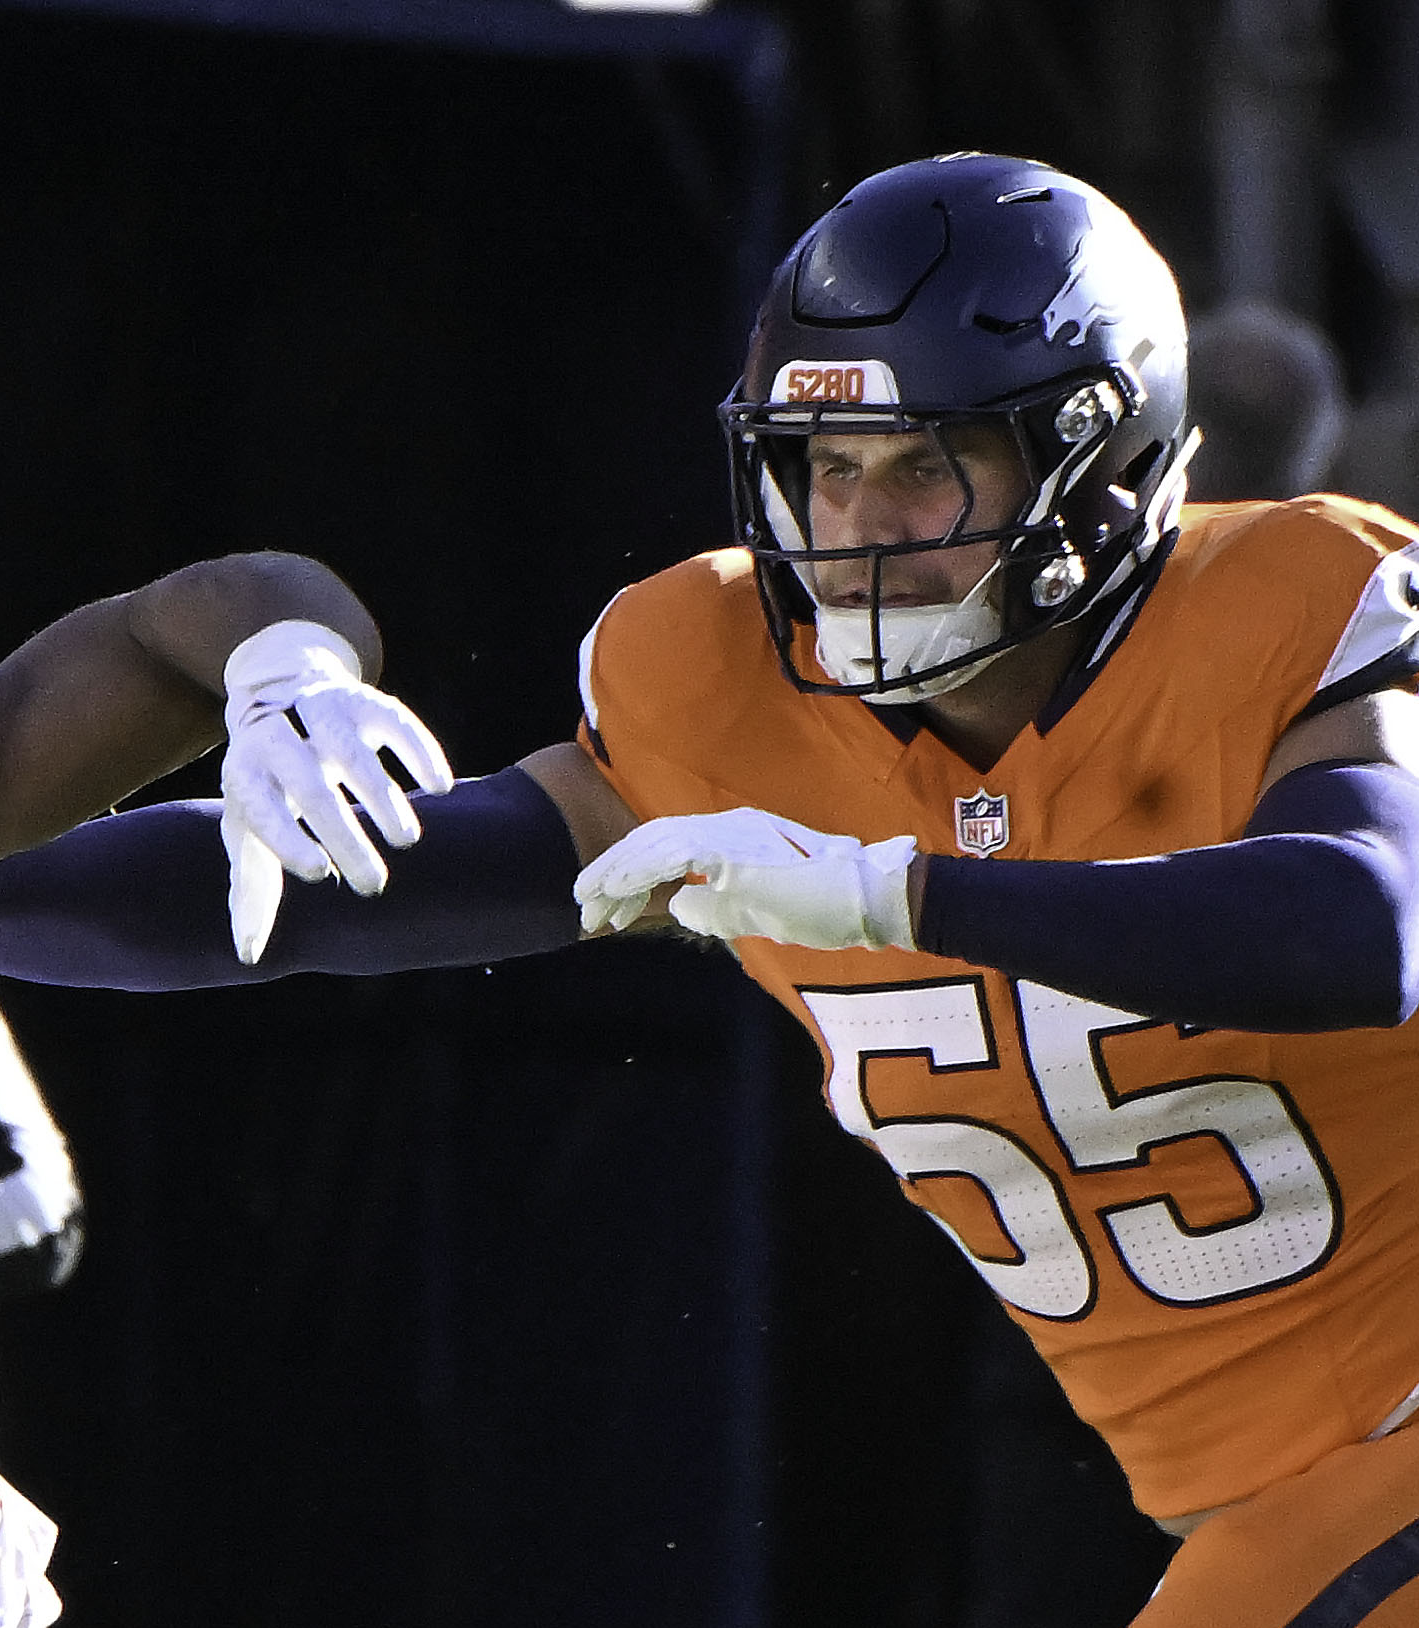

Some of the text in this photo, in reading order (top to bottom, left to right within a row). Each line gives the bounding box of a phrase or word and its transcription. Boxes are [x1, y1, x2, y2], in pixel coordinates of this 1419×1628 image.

[787, 368, 865, 403] 5280
[966, 820, 1001, 845] NFL
[793, 974, 1344, 1322] 55
